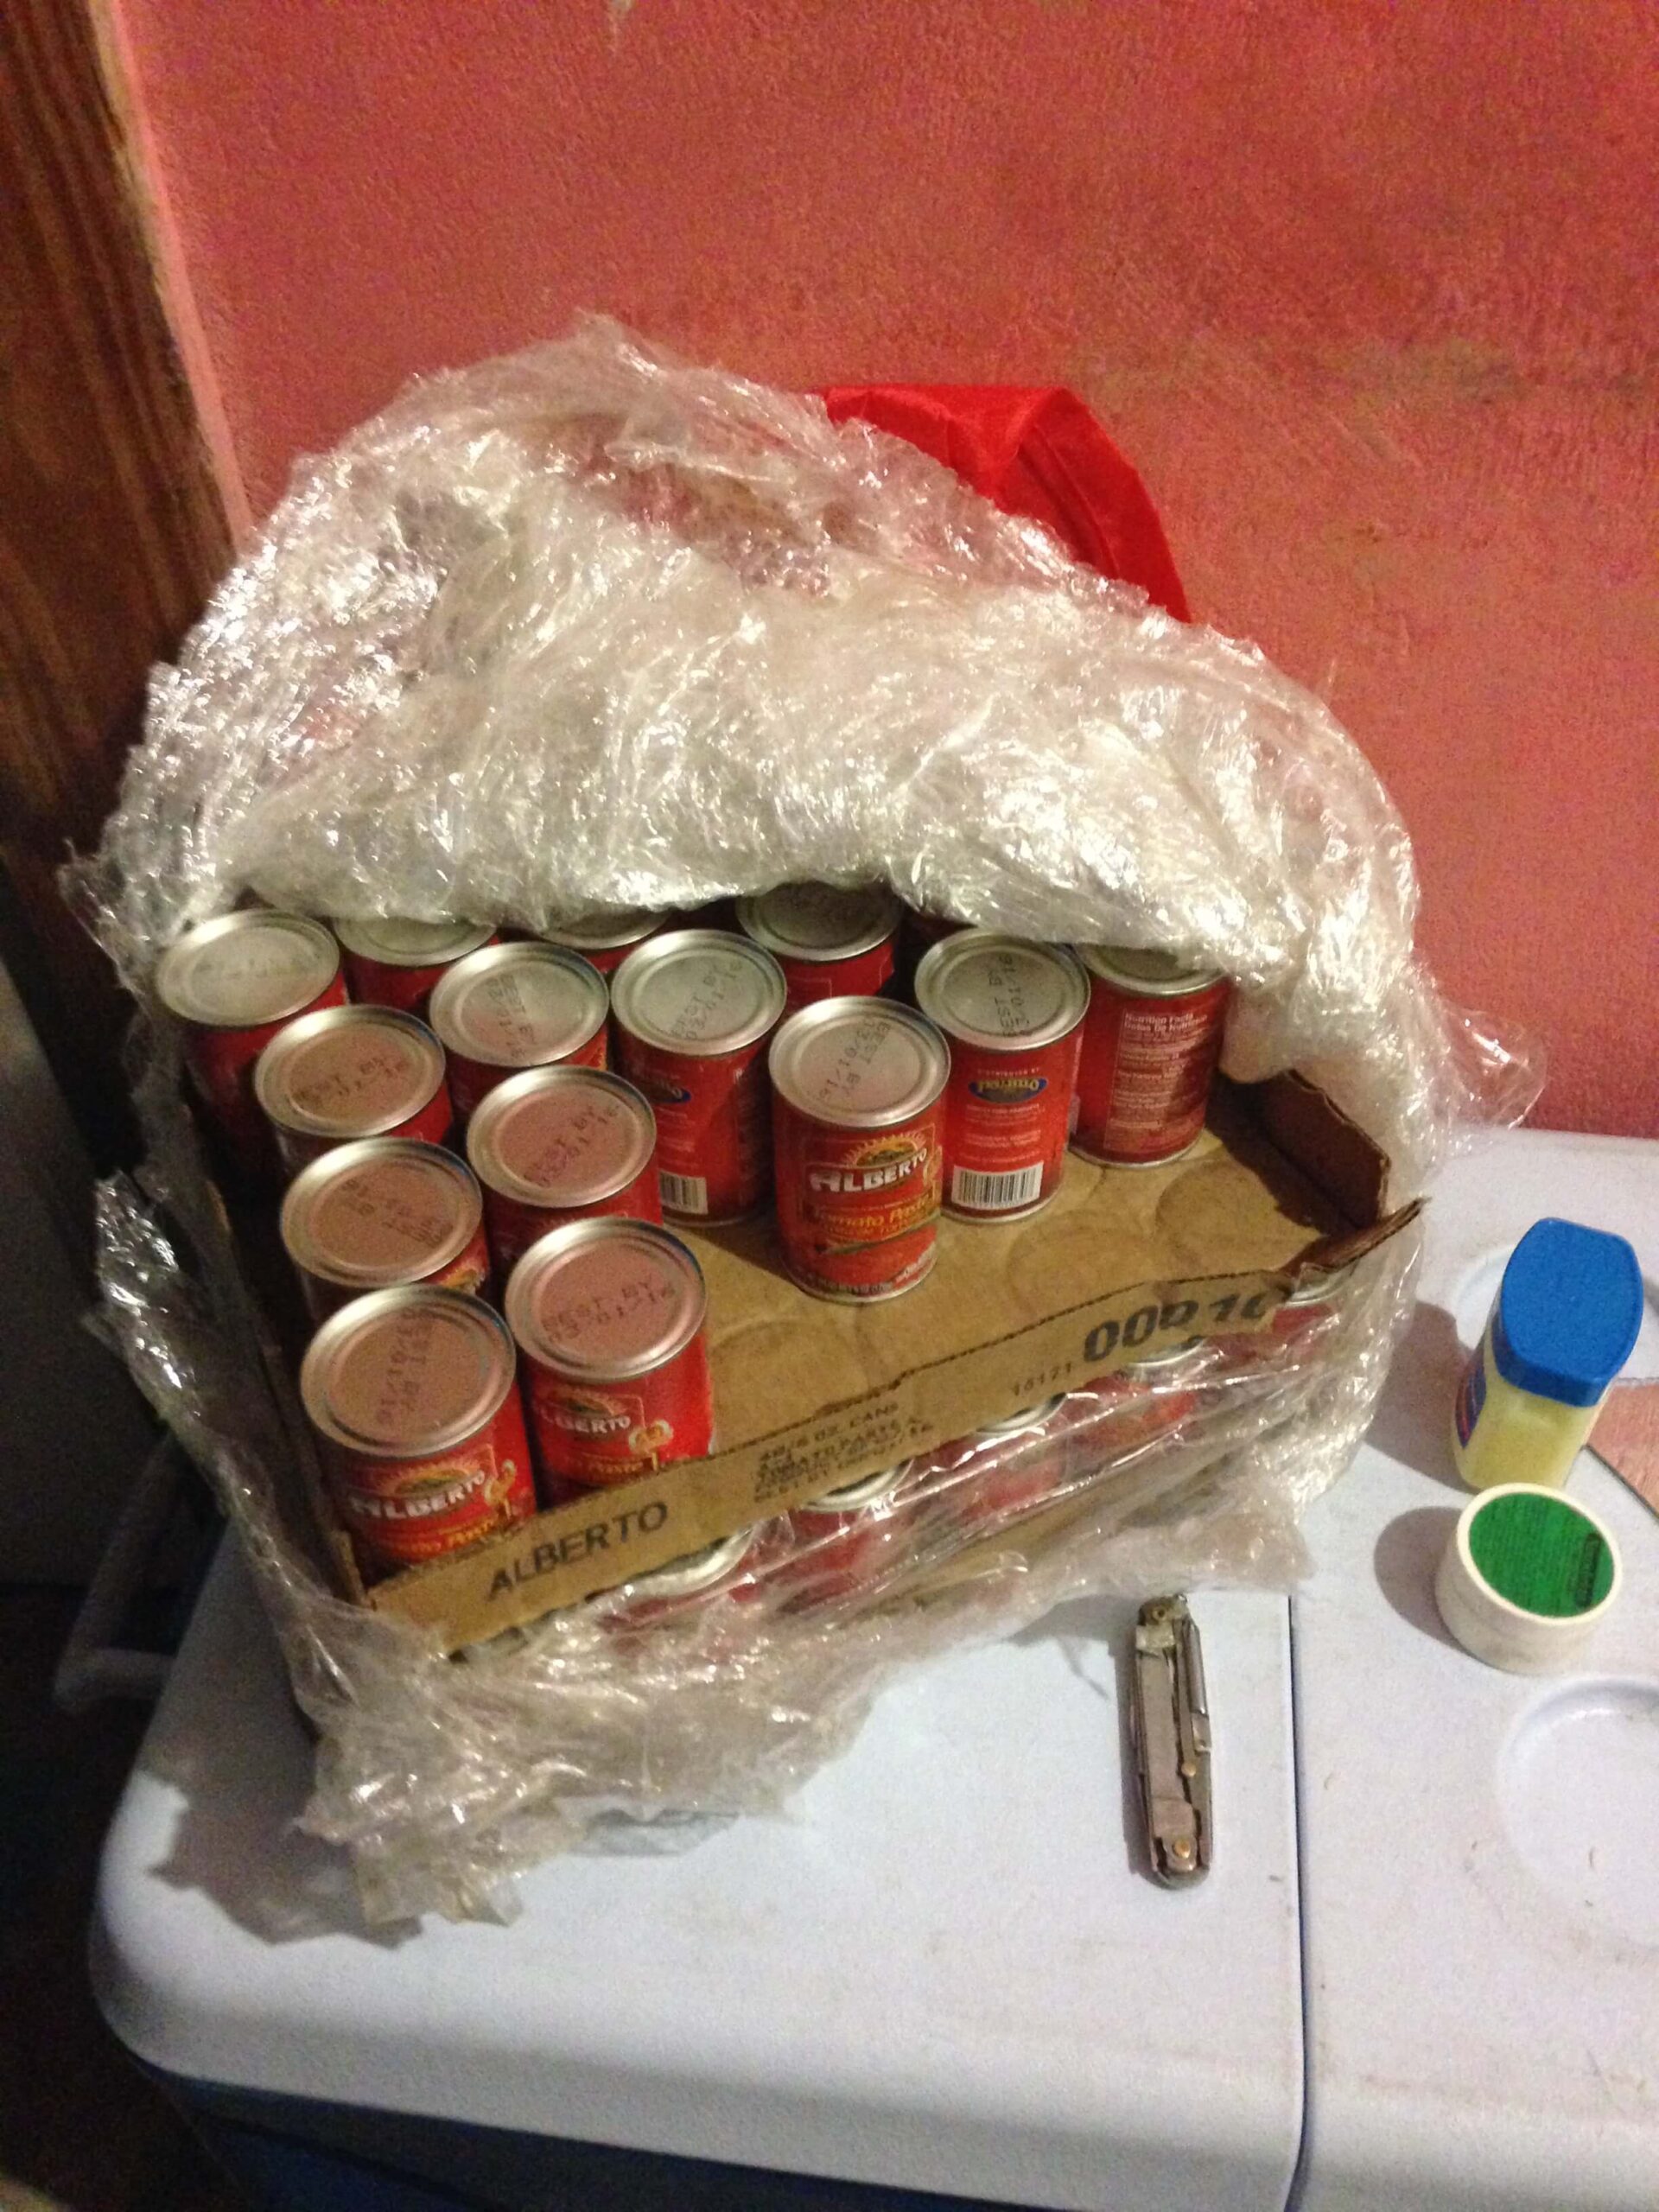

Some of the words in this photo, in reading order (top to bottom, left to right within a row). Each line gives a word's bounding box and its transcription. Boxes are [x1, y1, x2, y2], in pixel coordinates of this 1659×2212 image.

[808, 1147, 928, 1193] ALBERTO
[348, 1470, 486, 1520] ALBERTO
[480, 1501, 668, 1602] ALBERTO
